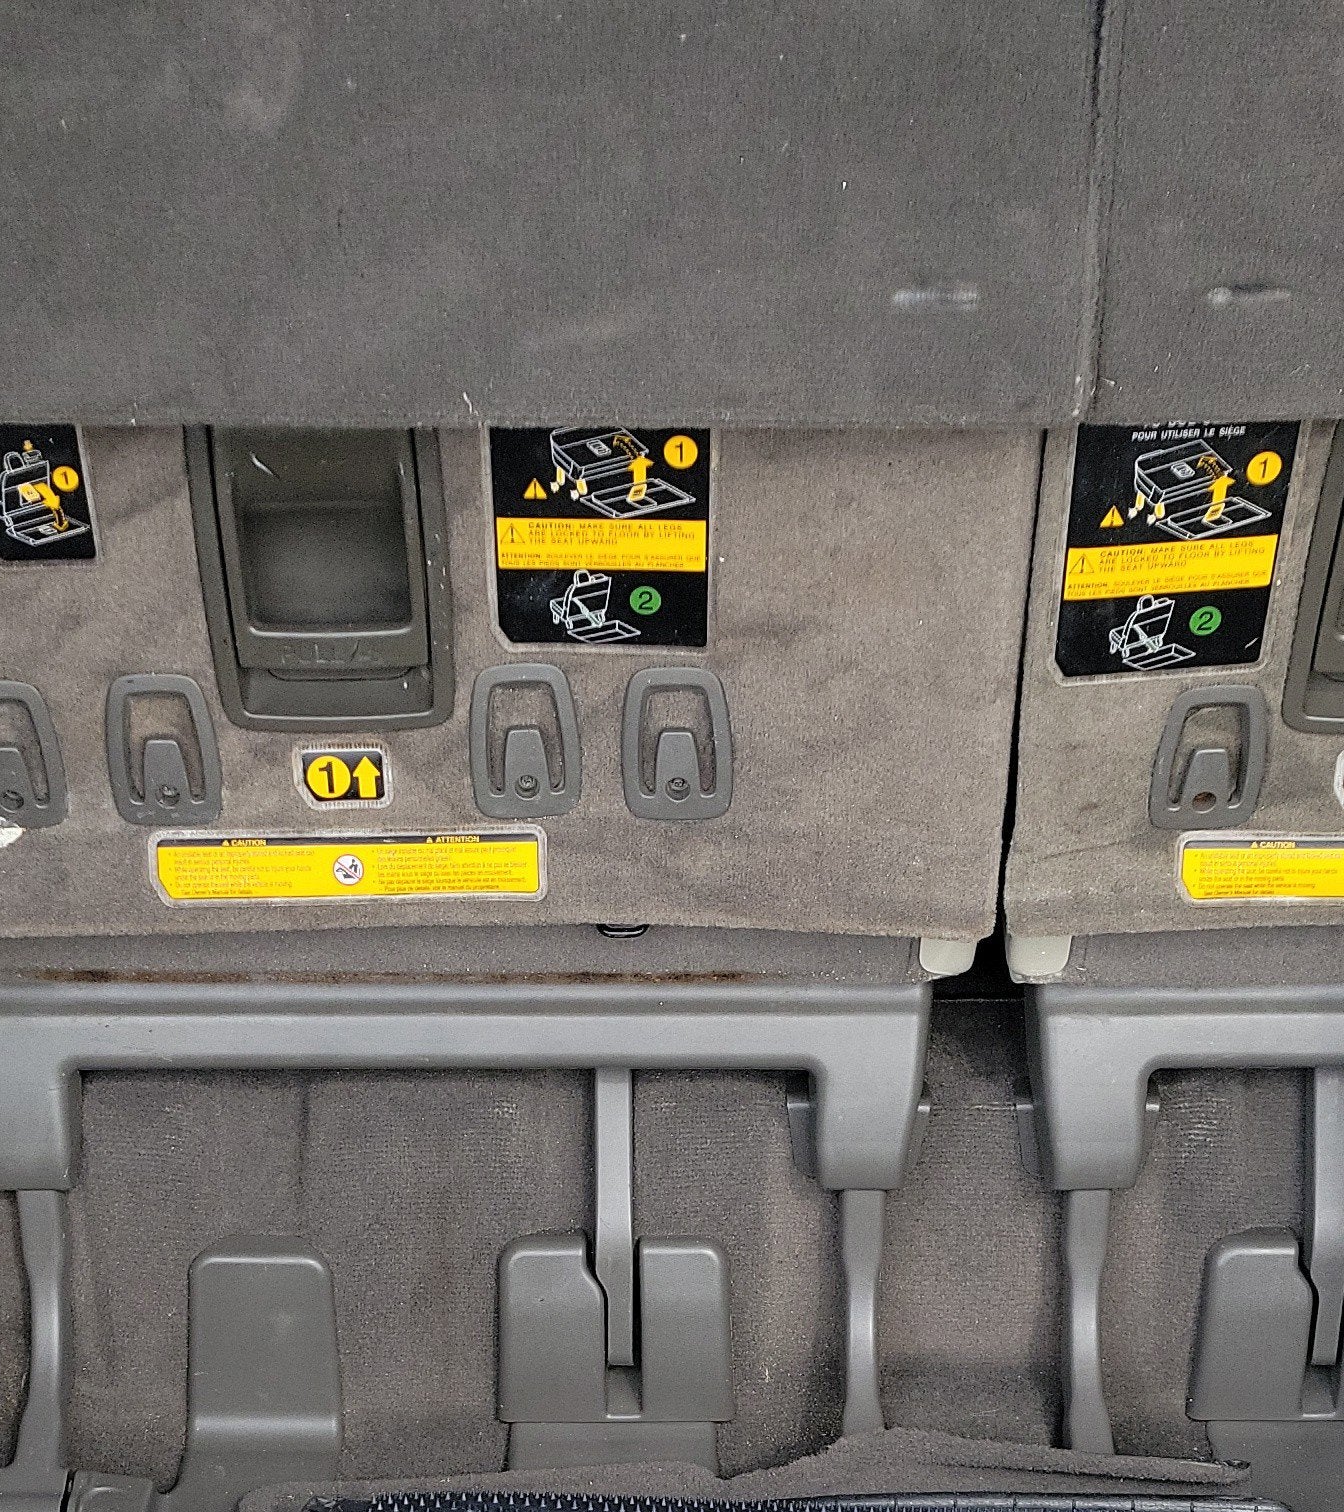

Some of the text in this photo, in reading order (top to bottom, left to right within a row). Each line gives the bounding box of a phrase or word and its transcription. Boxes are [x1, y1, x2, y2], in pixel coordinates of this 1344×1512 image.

[1131, 430, 1157, 442] POUR
[1160, 428, 1201, 441] UTILISER
[1203, 427, 1216, 438] LE
[231, 839, 267, 847] CAUTION
[435, 836, 480, 844] ATTENTION
[1259, 841, 1296, 849] CAUTION
